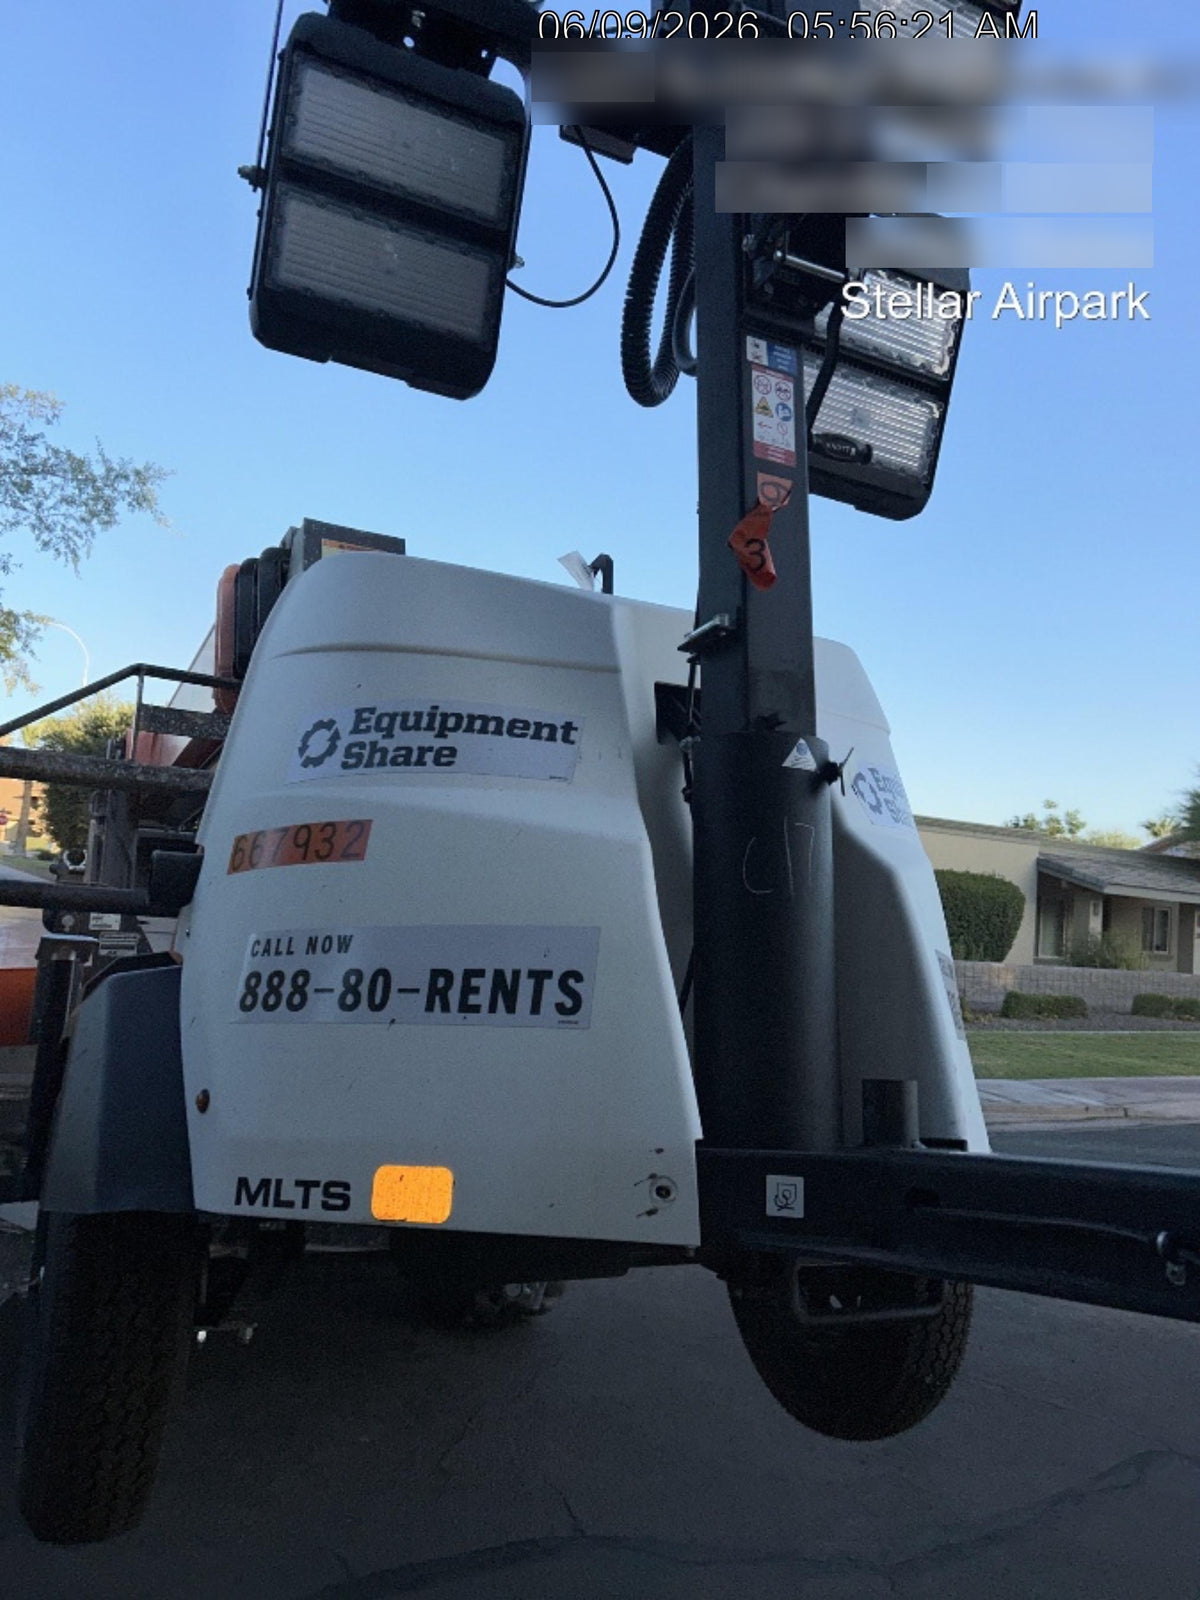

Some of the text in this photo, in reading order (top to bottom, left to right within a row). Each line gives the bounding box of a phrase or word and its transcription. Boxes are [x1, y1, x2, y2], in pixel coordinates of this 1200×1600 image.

[348, 705, 579, 745] Equipment
[341, 740, 458, 770] Share
[231, 819, 366, 873] 667932
[251, 934, 354, 957] CALL NOW
[239, 967, 585, 1016] 888-80-RENTS
[234, 1176, 351, 1212] MLTS
